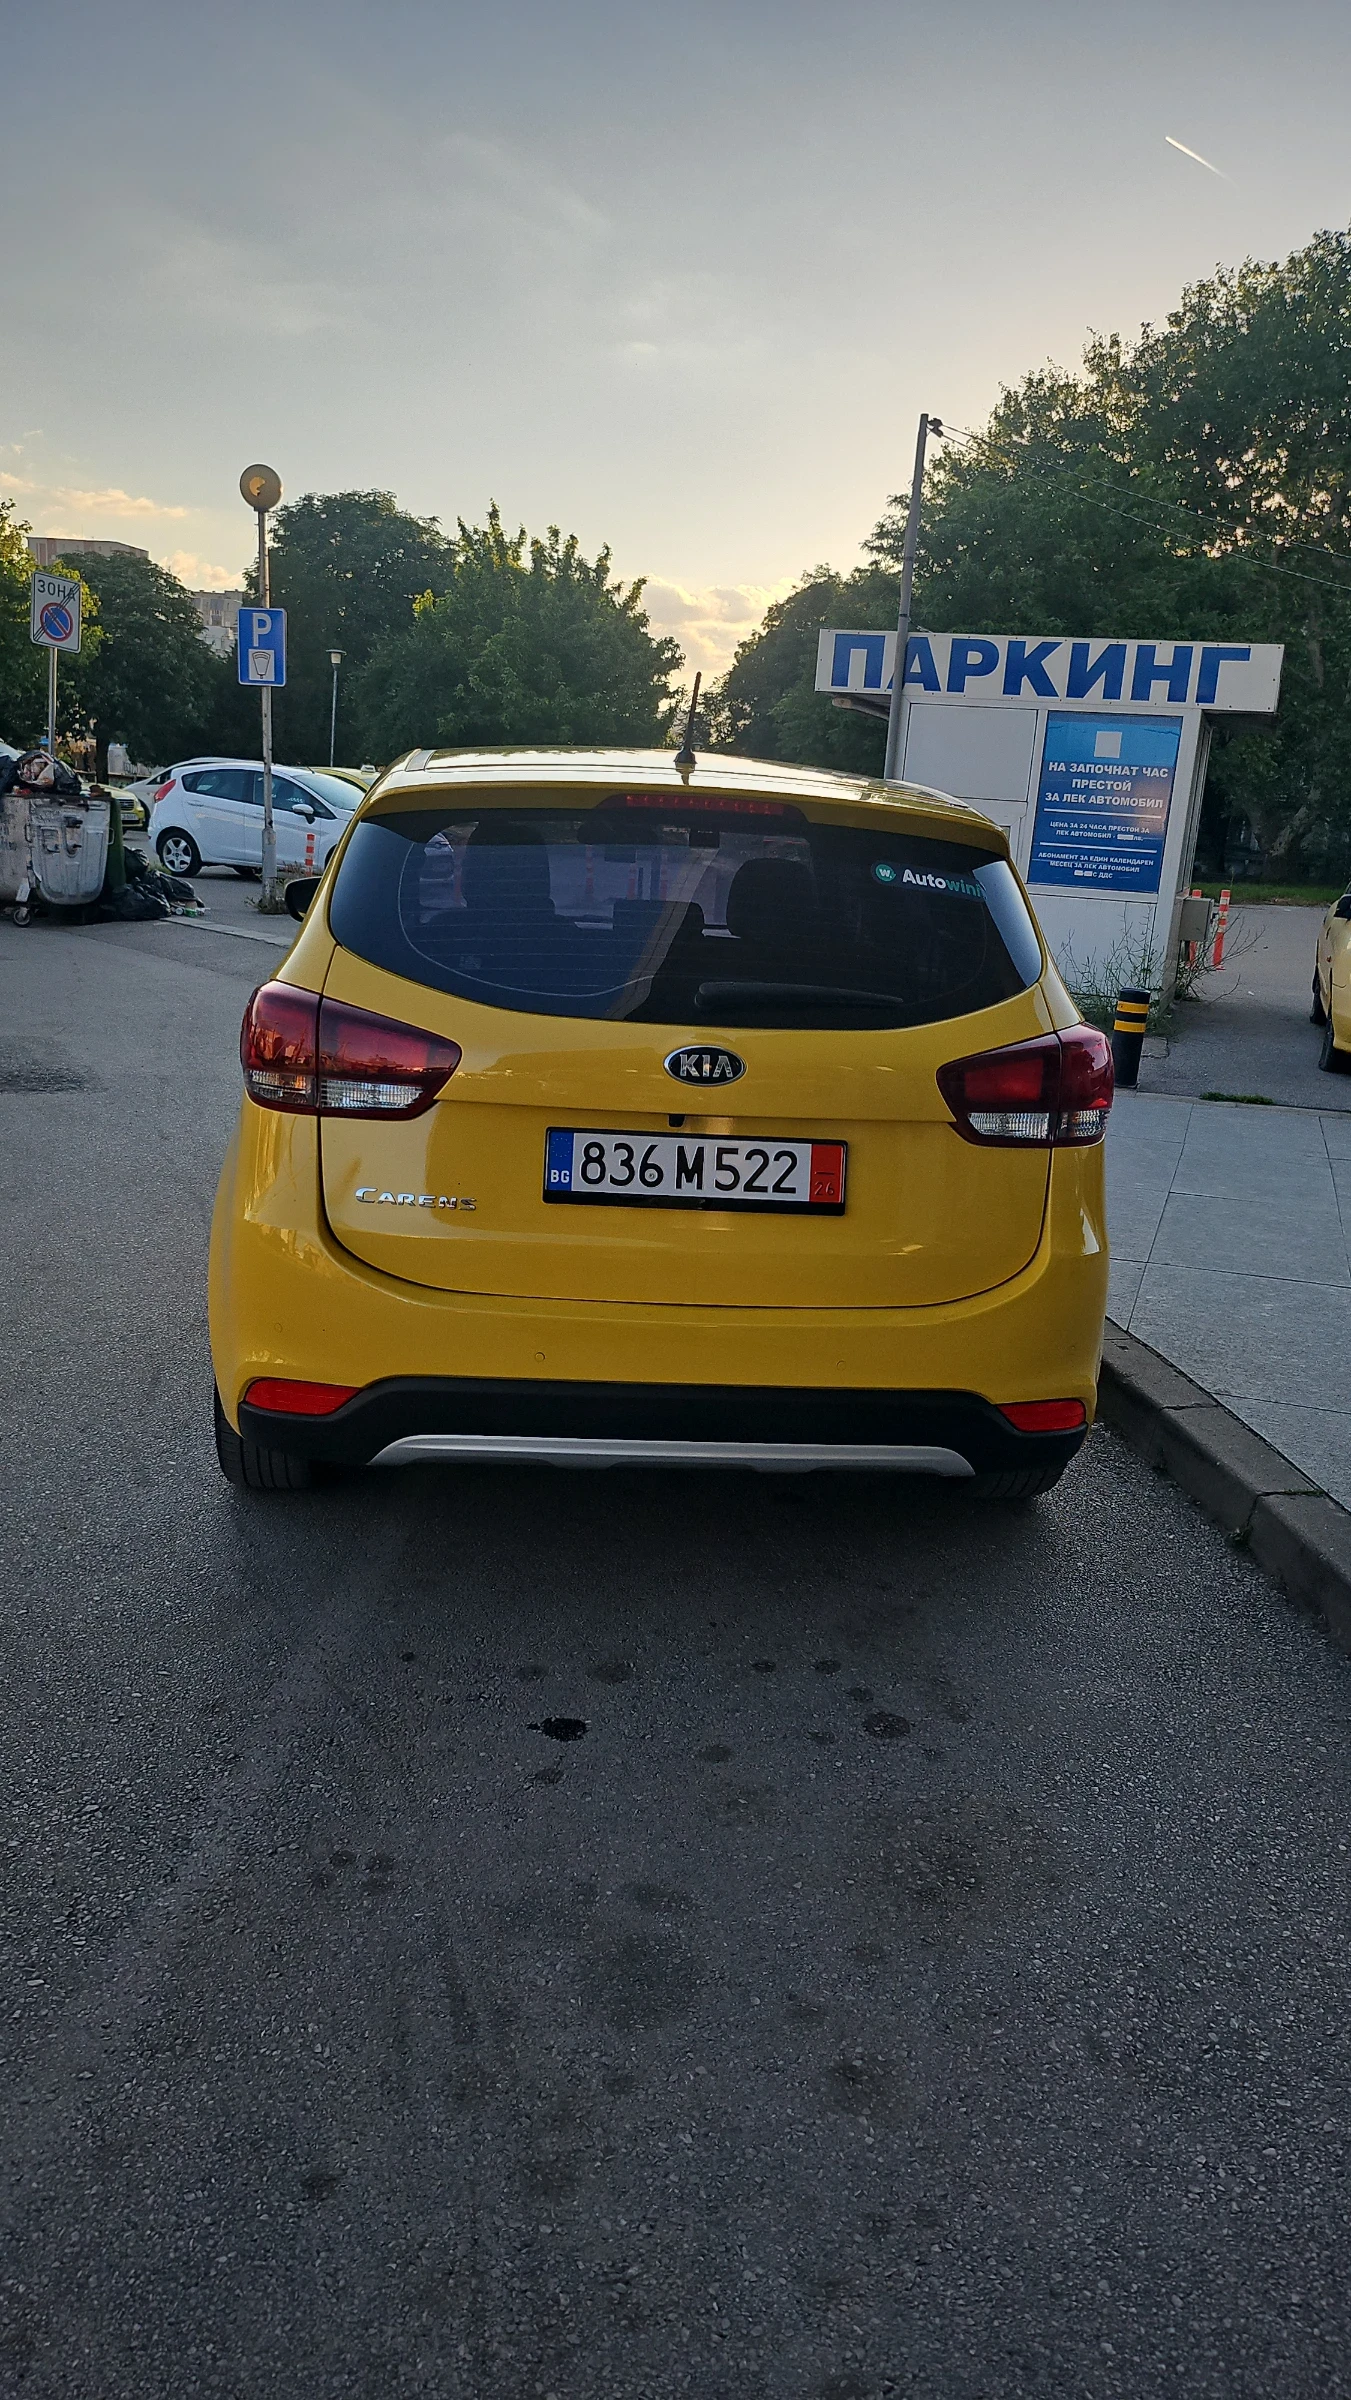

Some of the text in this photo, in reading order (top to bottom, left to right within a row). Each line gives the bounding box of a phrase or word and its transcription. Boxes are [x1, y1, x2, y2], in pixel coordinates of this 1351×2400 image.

[37, 580, 76, 601] ЗОНА
[252, 612, 272, 647] P
[831, 633, 1251, 704] ПАРКИНГ
[1048, 762, 1169, 778] НА ЗАПОЧНАТ ЧАС
[1071, 779, 1132, 791] ПРЕСТОЙ
[1045, 792, 1163, 808] ЗА ЛЕК АВТОМОБИЛ
[1050, 821, 1069, 829] ЦЕНА
[1088, 823, 1107, 831] ЧАСА
[1070, 831, 1112, 839] АВТОМОБИЛ
[1038, 852, 1078, 860] АБОНАМЕНТ
[1049, 861, 1073, 869] МЕСЕЦ
[1098, 864, 1140, 873] АВТОМОБИЛ
[679, 1054, 733, 1078] KIA
[550, 1169, 570, 1184] BG
[815, 1181, 834, 1196] 26
[355, 1187, 477, 1211] CARENS
